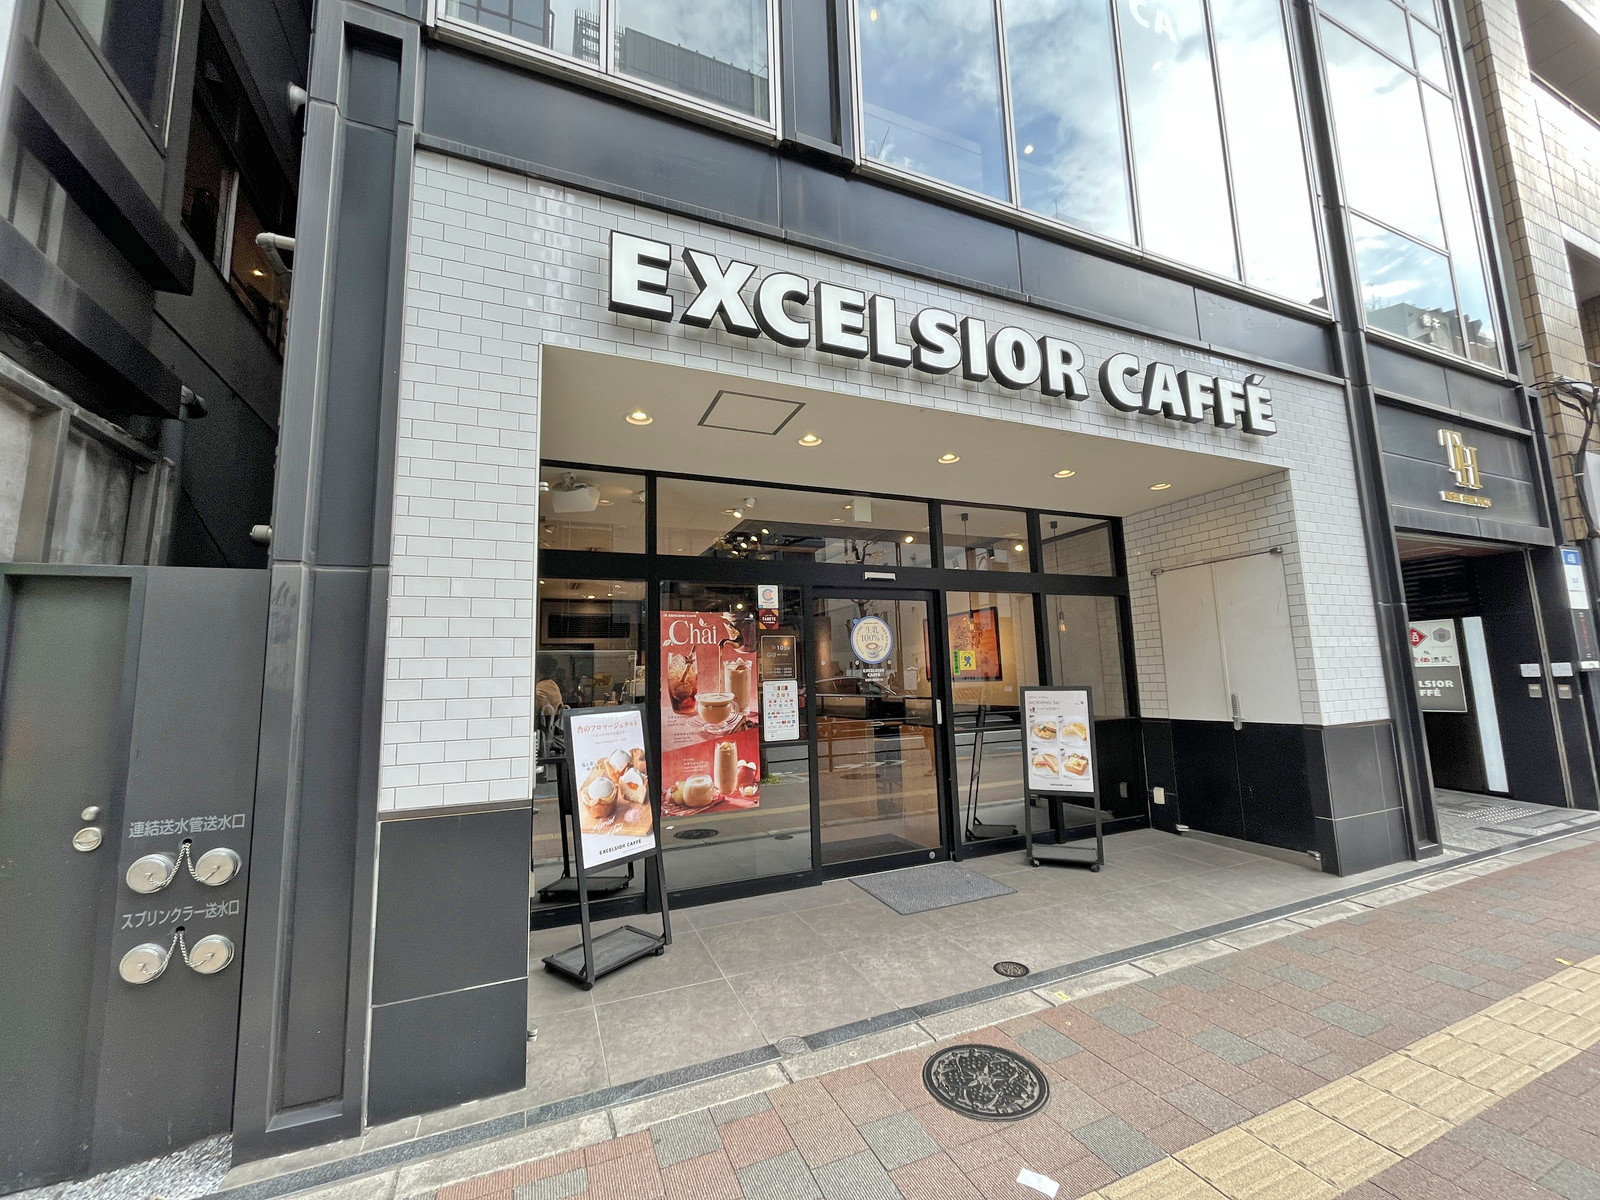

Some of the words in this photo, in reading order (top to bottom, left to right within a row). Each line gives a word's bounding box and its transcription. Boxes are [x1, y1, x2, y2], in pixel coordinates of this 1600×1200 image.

[608, 231, 1089, 402] EXCELSIOR
[1098, 350, 1277, 437] CAFFÉ
[668, 619, 717, 645] Chai
[861, 633, 880, 642] 100%
[1418, 680, 1454, 688] LSIOR
[1419, 687, 1442, 697] FFÉ
[128, 813, 246, 839] 連結送水管送水口
[599, 843, 626, 856] EXCELSIOR
[121, 899, 240, 930] スプリンクラー送水口
